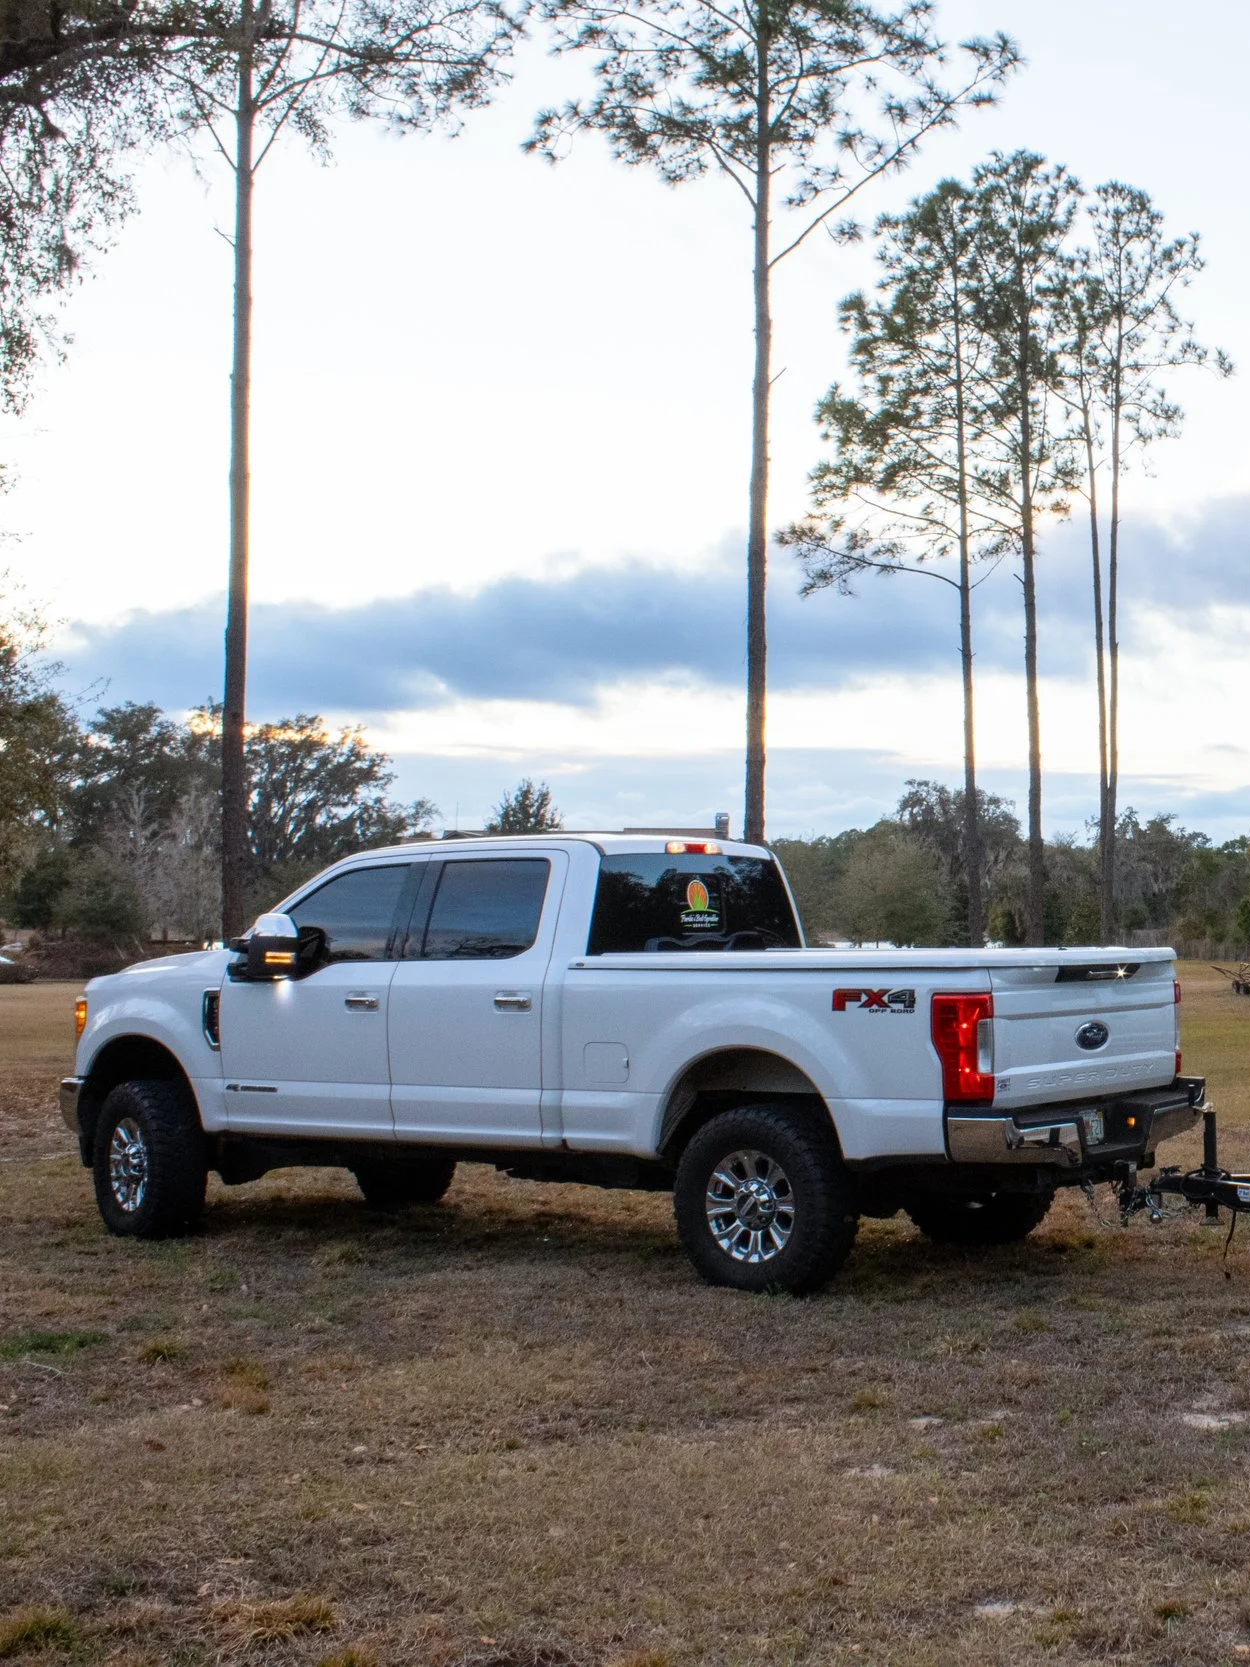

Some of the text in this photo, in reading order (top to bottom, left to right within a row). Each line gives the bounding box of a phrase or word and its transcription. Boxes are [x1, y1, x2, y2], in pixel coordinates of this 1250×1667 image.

[832, 988, 917, 1012] FX4
[1026, 1071, 1101, 1090] SUPER
[1104, 1063, 1154, 1081] DUTY
